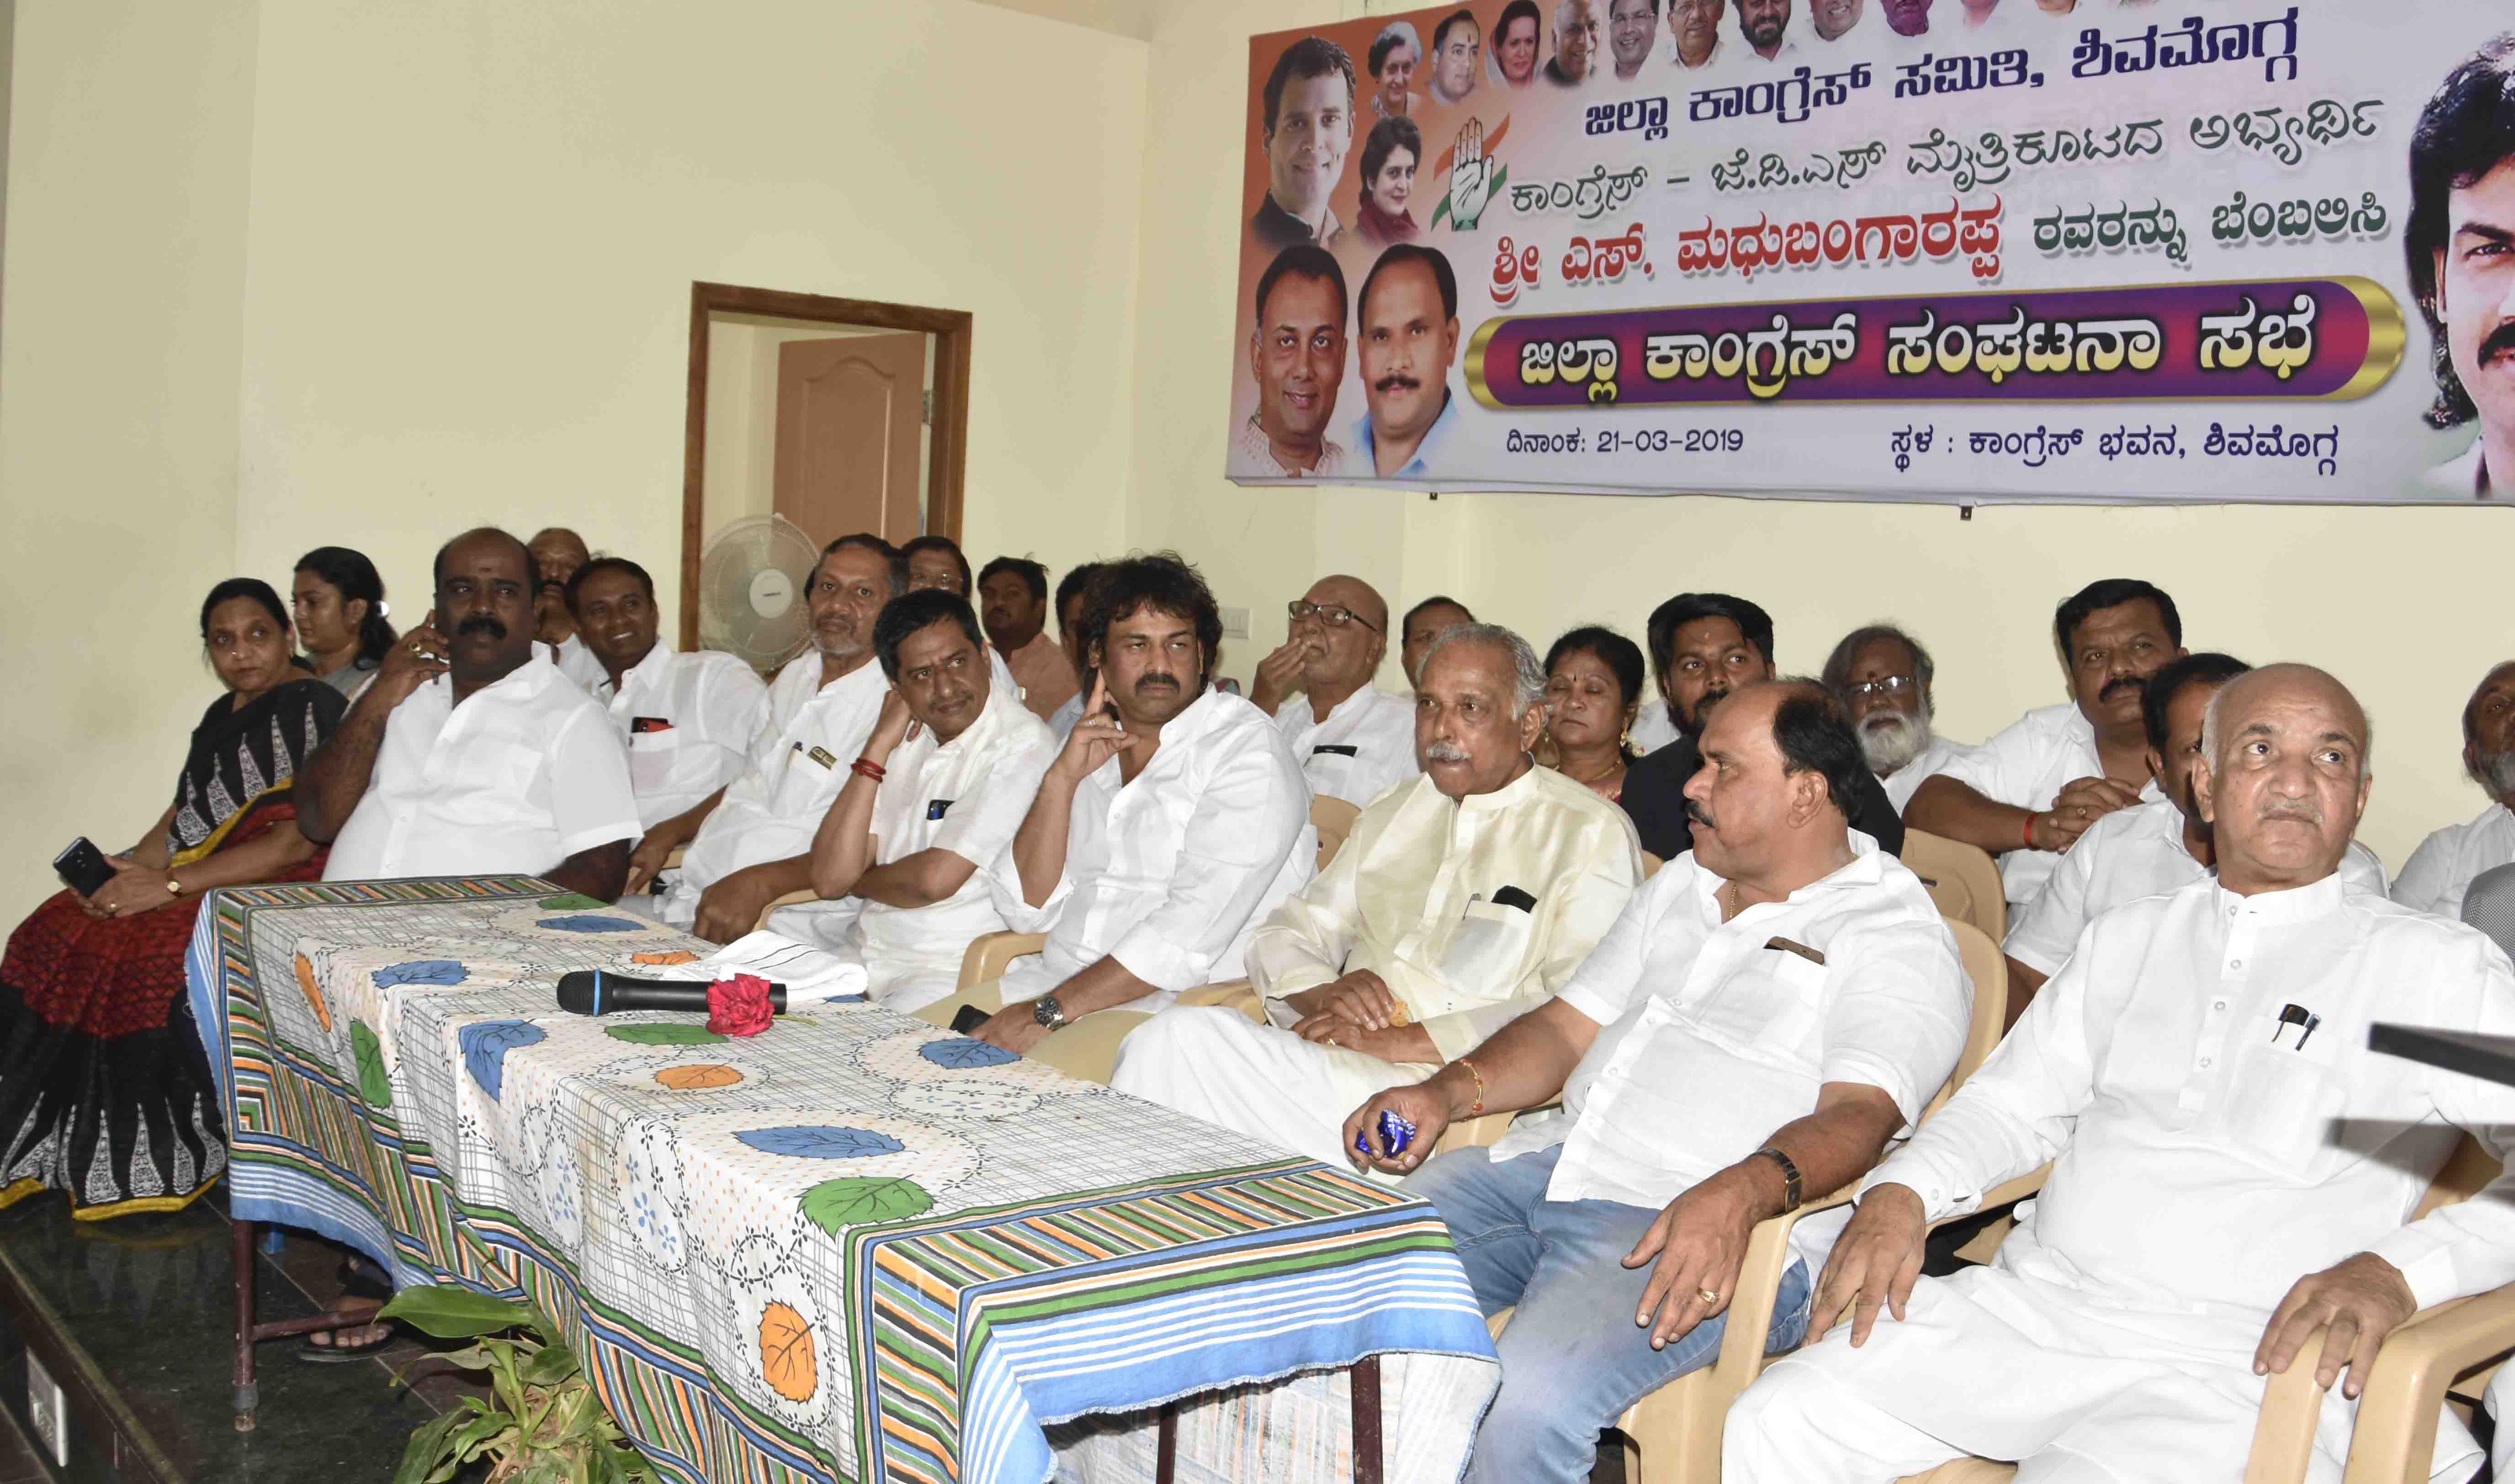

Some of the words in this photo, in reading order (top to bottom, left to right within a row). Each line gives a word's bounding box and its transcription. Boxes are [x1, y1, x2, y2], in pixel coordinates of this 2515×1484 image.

[1585, 96, 1669, 141] ಜಿಲ್ಲಾ
[1689, 62, 1872, 124] ಕಾಂಗ್ರೆಸ್
[1894, 48, 2044, 99] ಸಮಿತಿ,
[2071, 6, 2299, 83] ಶಿವಮೊಗ್ಗ
[1511, 164, 1648, 220] ಕಾಂಗ್ರೆಸ್
[1906, 118, 2163, 192] ಮೈತ್ರಿಕೂಟದ
[2190, 99, 2384, 166] ಅಭ್ಯರ್ಥಿ
[1491, 237, 1539, 303] ಶ್ರೀ
[1562, 223, 1653, 280] ಎಸ್.
[1678, 195, 2001, 278] ಮಧುಬಂಗಾರಪ್ಪ
[2033, 197, 2188, 263] ರವರನ್ನು
[2211, 191, 2387, 240] ಬೆಂಬಲಿಸಿ
[1521, 339, 1617, 402] ಜಿಲ್ಲಾ
[1646, 313, 1856, 398] ಕಾಂಗ್ರೆಸ್
[1888, 307, 2160, 383] ಸಂಘಟನಾ
[2200, 294, 2315, 379] ಸಭೆ
[1506, 427, 1586, 454] ದಿನಾಂಕ:
[1596, 428, 1744, 453] 21-03-2019
[1891, 423, 1934, 473] ಸ್ಥಳ
[1968, 424, 2085, 468] ಕಾಂಗ್ರೆಸ್
[2098, 424, 2186, 461] ಭವನ,
[2203, 422, 2339, 477] ಶಿವಮೊಗ್ಗ
